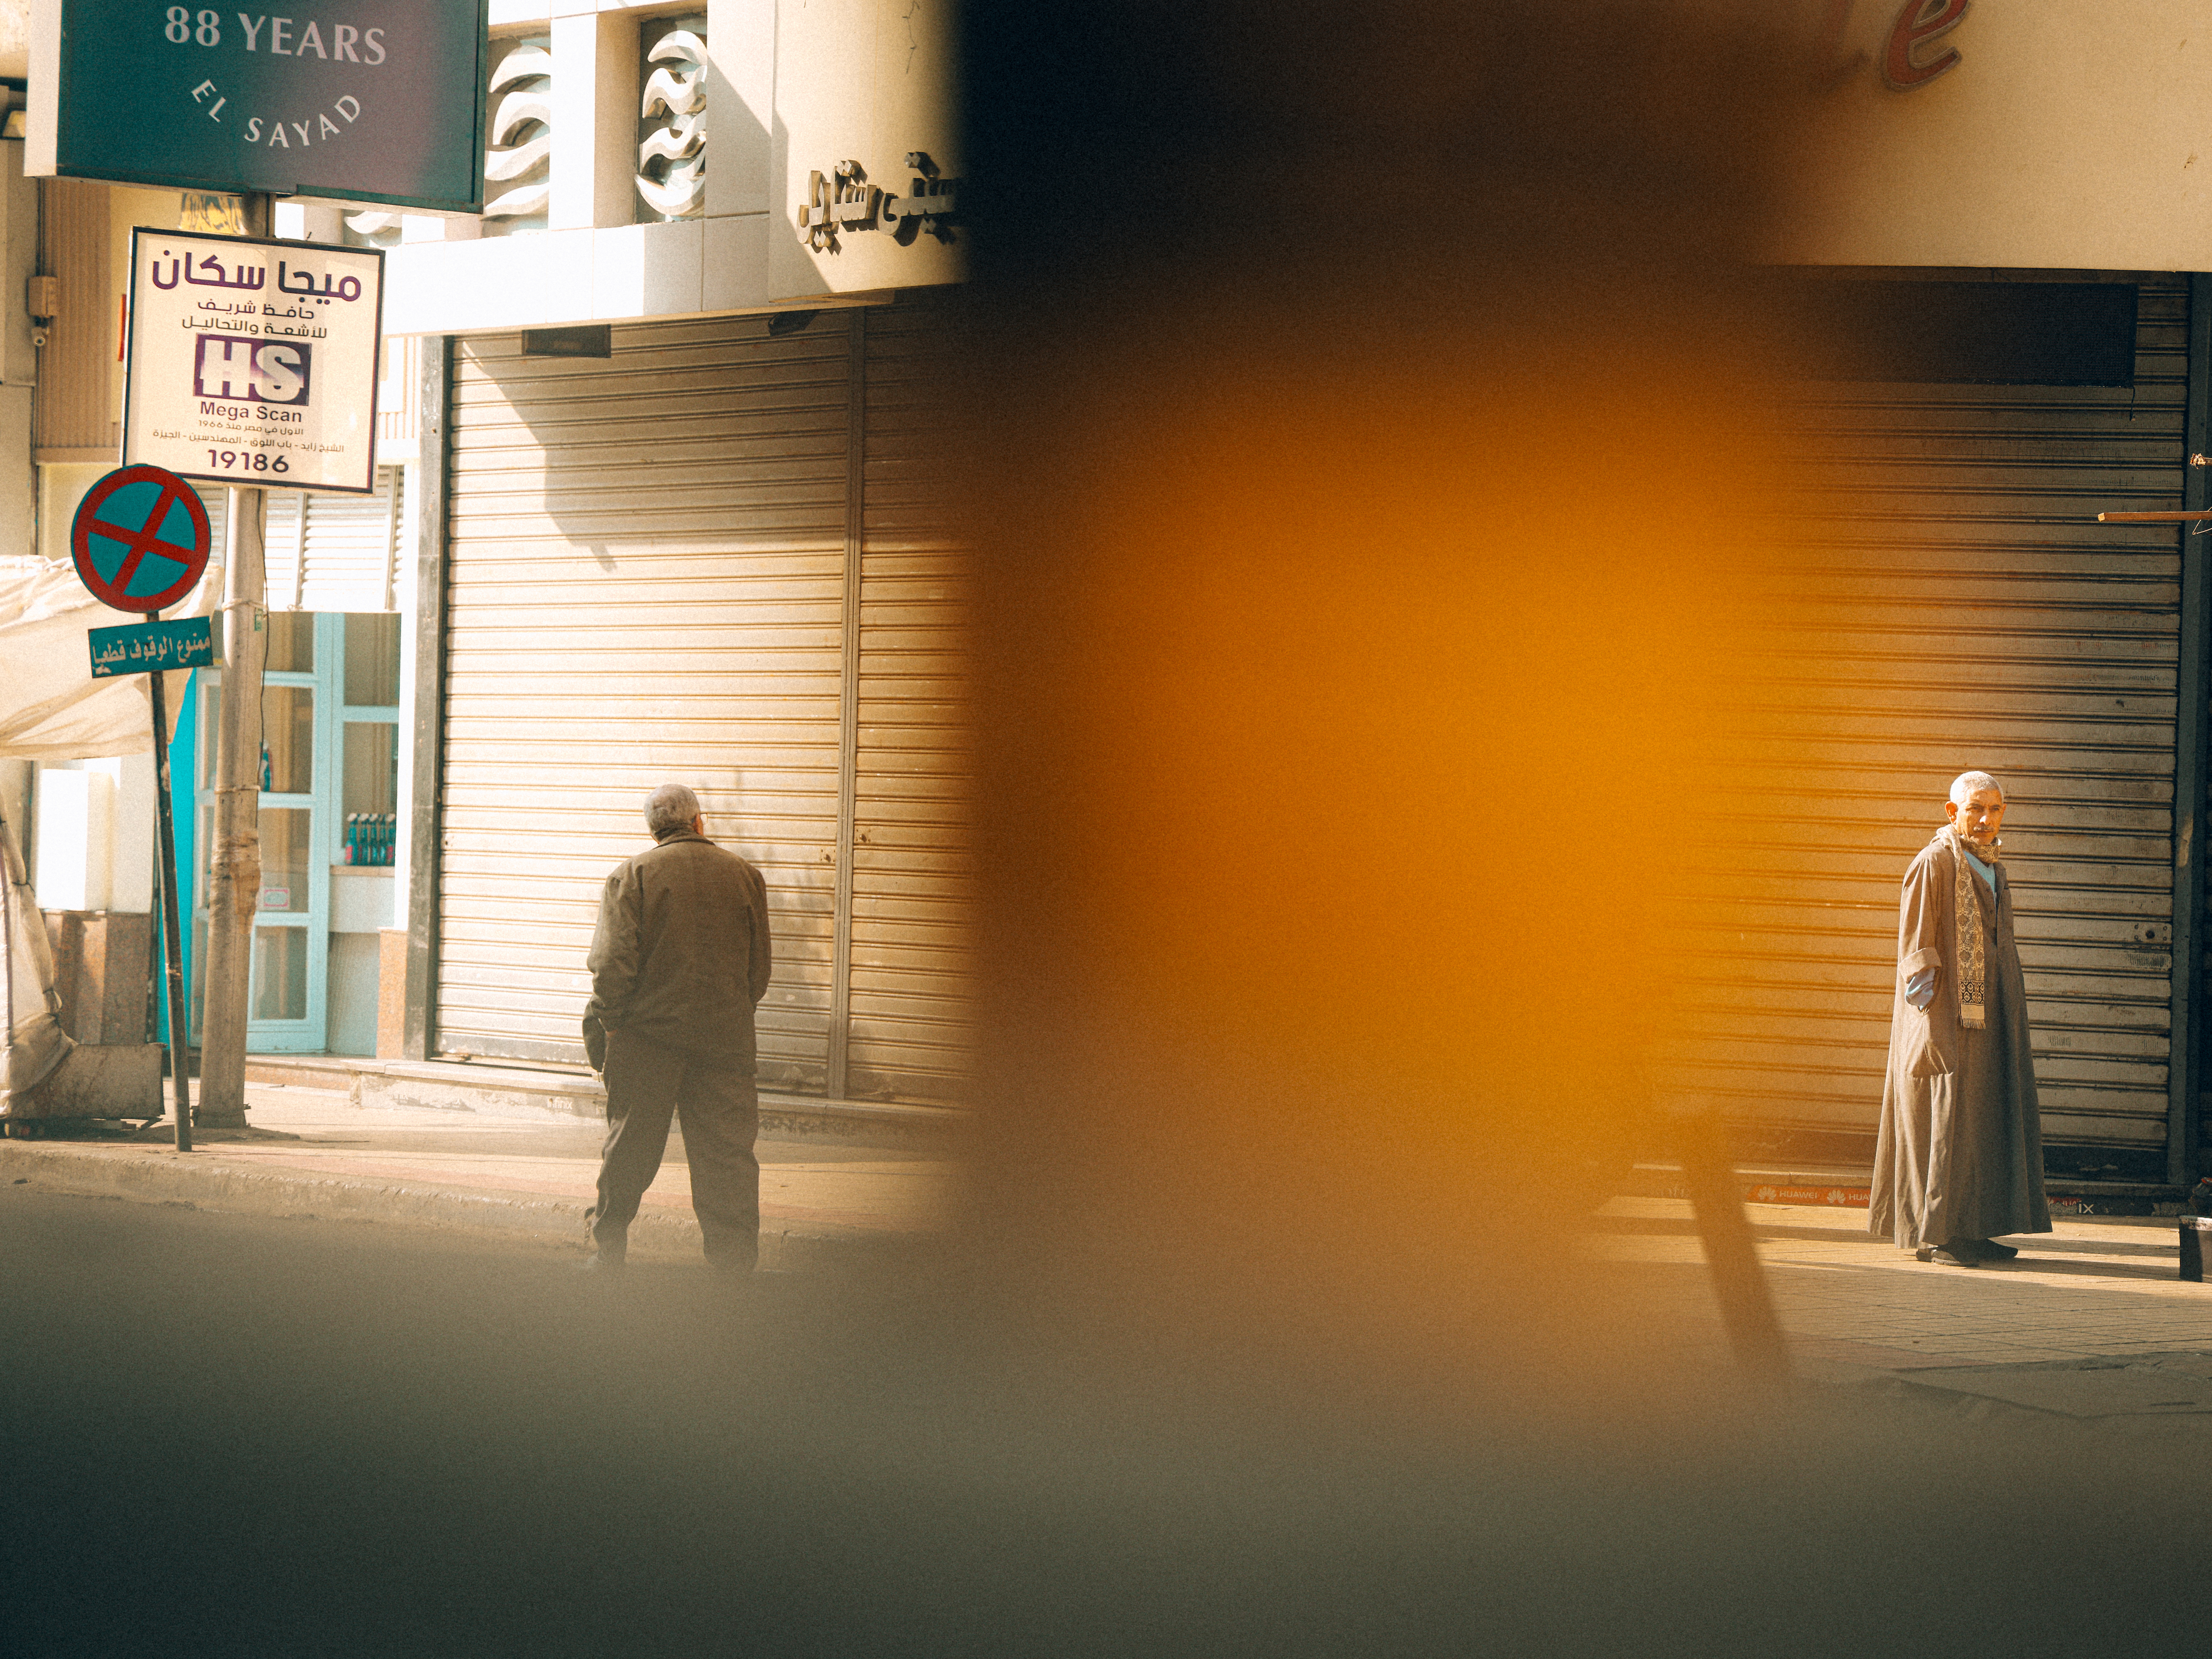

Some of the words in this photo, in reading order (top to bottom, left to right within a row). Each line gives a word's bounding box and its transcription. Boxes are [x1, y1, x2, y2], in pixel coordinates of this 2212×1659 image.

[165, 6, 220, 47] 88
[238, 13, 387, 65] YEARS
[192, 79, 227, 123] EL
[244, 95, 361, 148] SAYAD
[153, 250, 265, 290] سكان
[278, 261, 361, 305] ميجا
[198, 299, 256, 315] شريف
[262, 303, 314, 319] حافظ
[182, 316, 259, 335] والتحاليل
[200, 339, 304, 401] HS
[200, 401, 249, 421] Mega
[256, 406, 302, 422] Scan
[153, 429, 180, 440] الجيزة
[226, 422, 242, 430] منذ
[189, 432, 242, 444] المهندسين
[250, 438, 275, 448] اللوق
[277, 441, 292, 450] باب
[301, 442, 316, 452] زايد
[319, 442, 345, 453] الشيخ
[207, 449, 289, 473] 19186
[130, 635, 173, 662] الوقوف
[177, 633, 211, 664] ممنوع
[1779, 1190, 1817, 1199] HUAWEI
